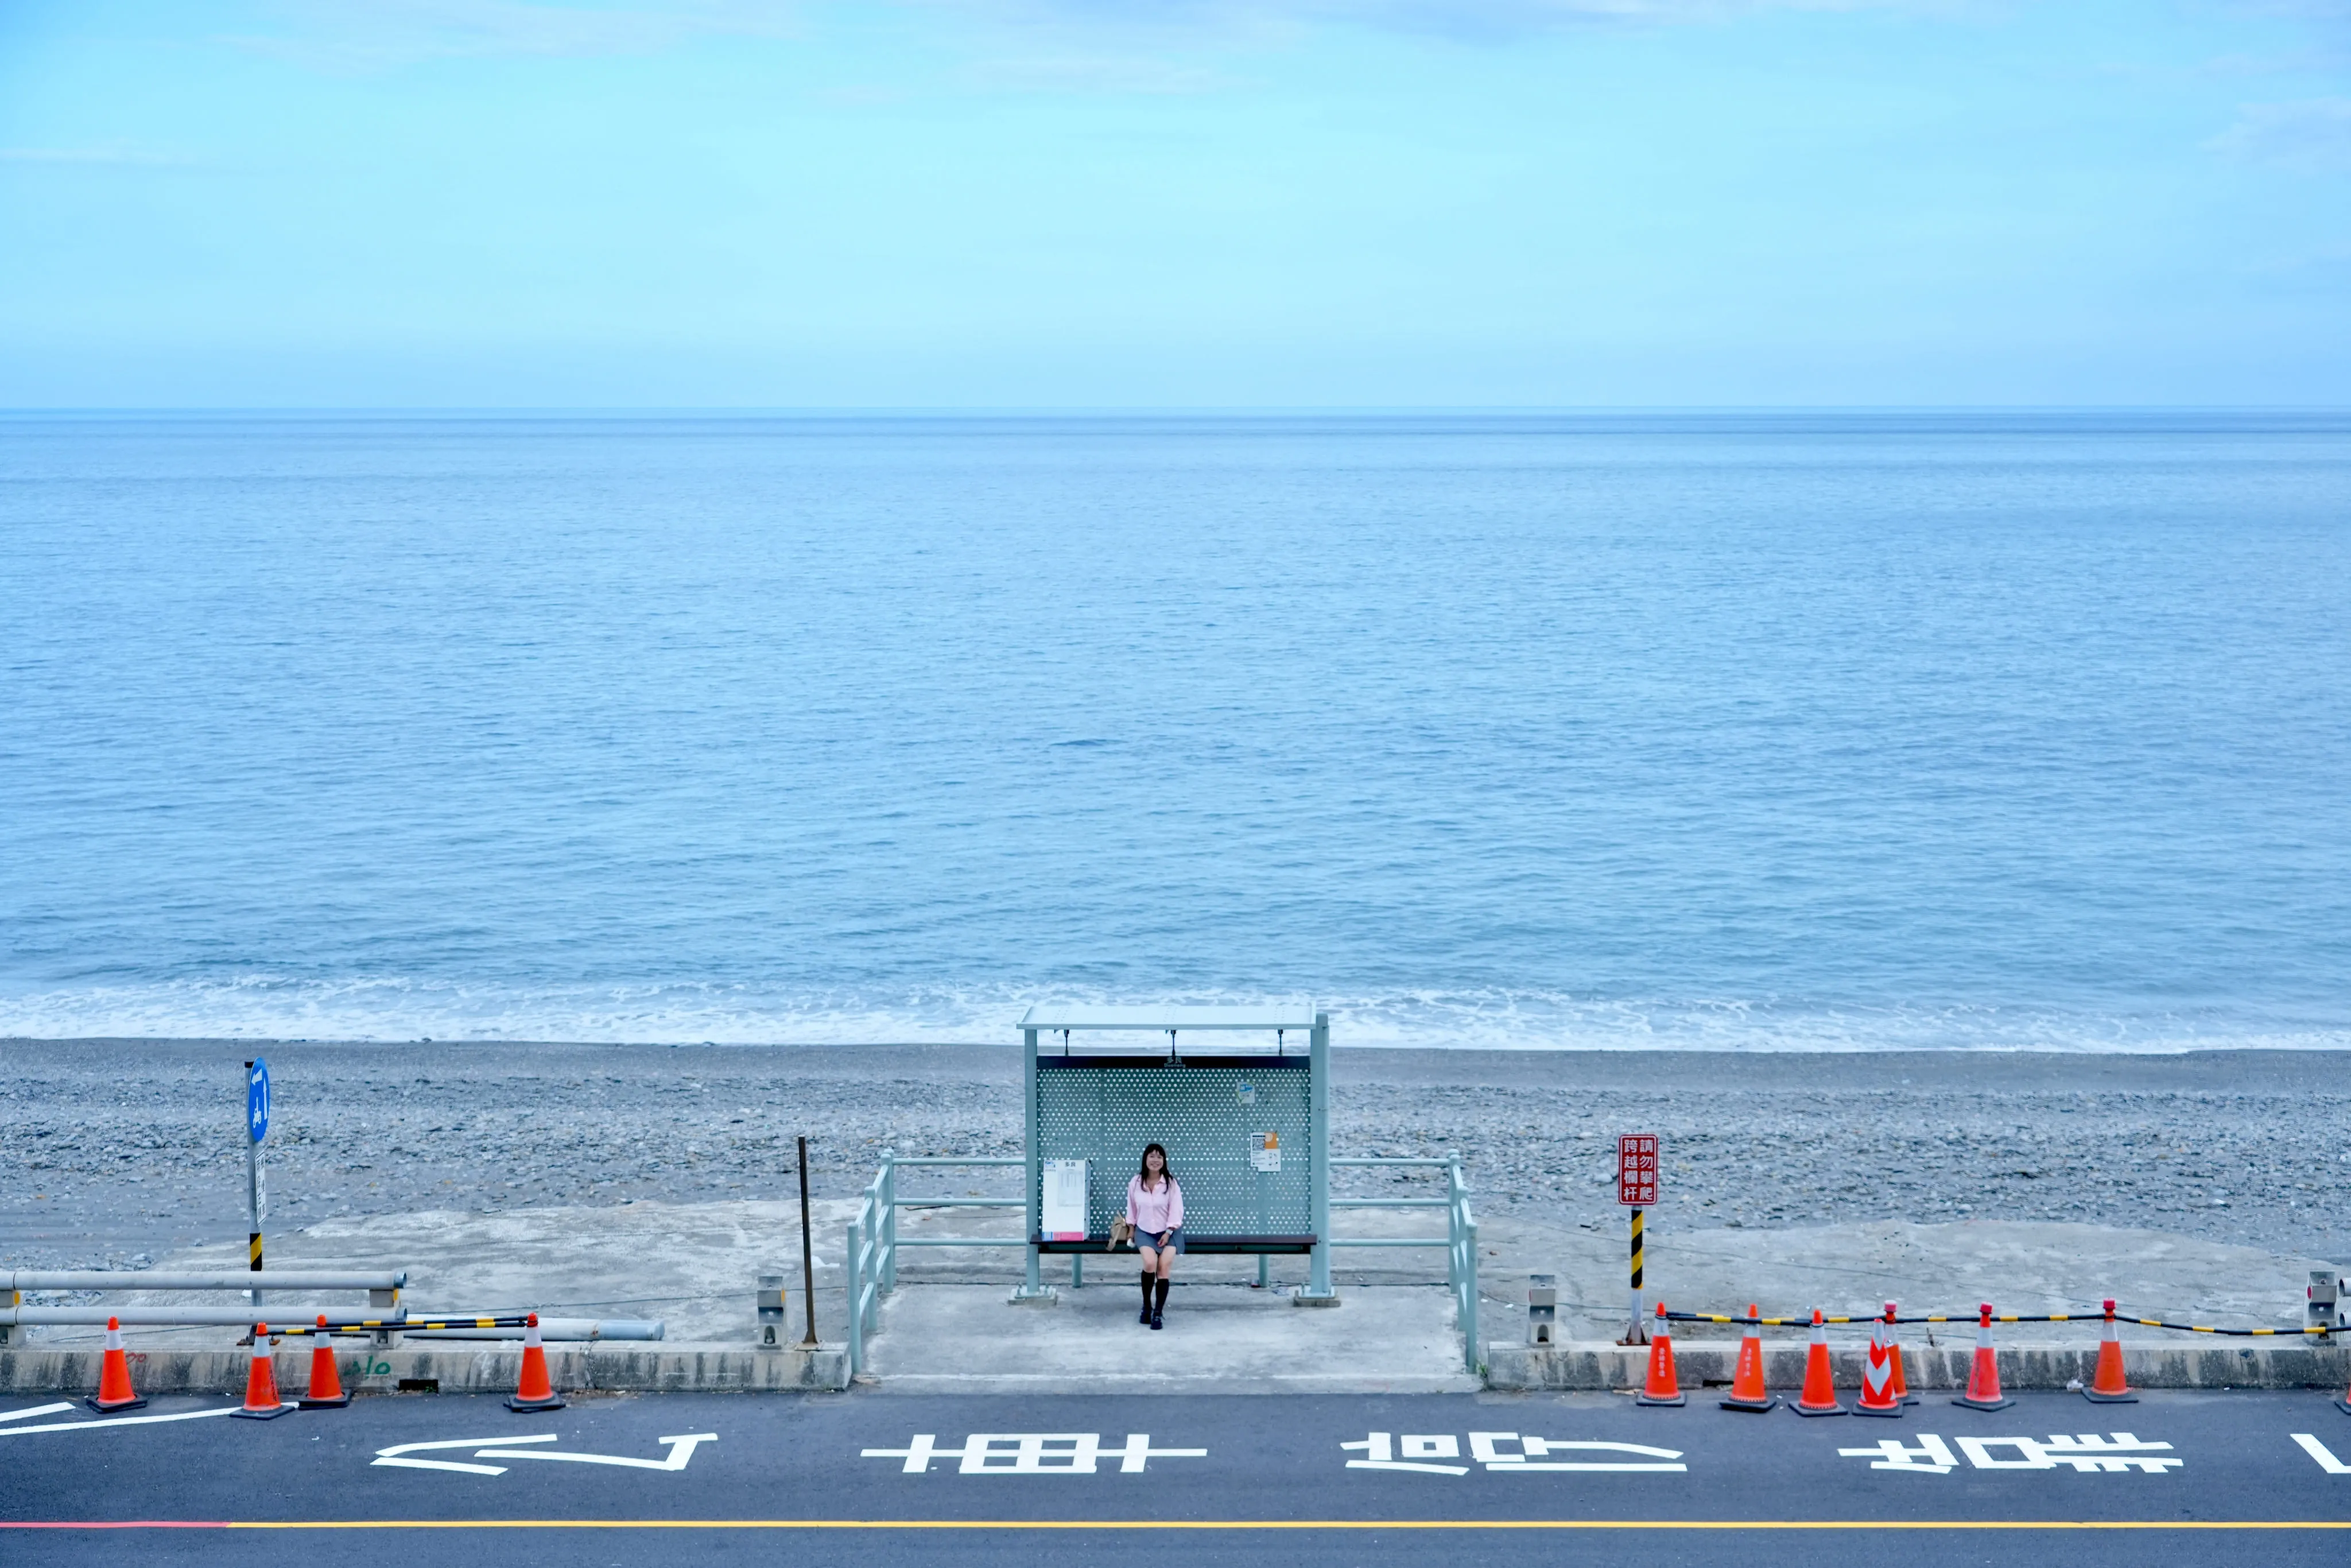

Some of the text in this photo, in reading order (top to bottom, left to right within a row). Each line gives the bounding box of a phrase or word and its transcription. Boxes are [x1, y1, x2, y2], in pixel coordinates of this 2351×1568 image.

[1624, 1139, 1638, 1200] 跨越欄杆
[1639, 1139, 1653, 1200] 請勿攀爬
[370, 1431, 2351, 1475] 公車停靠
